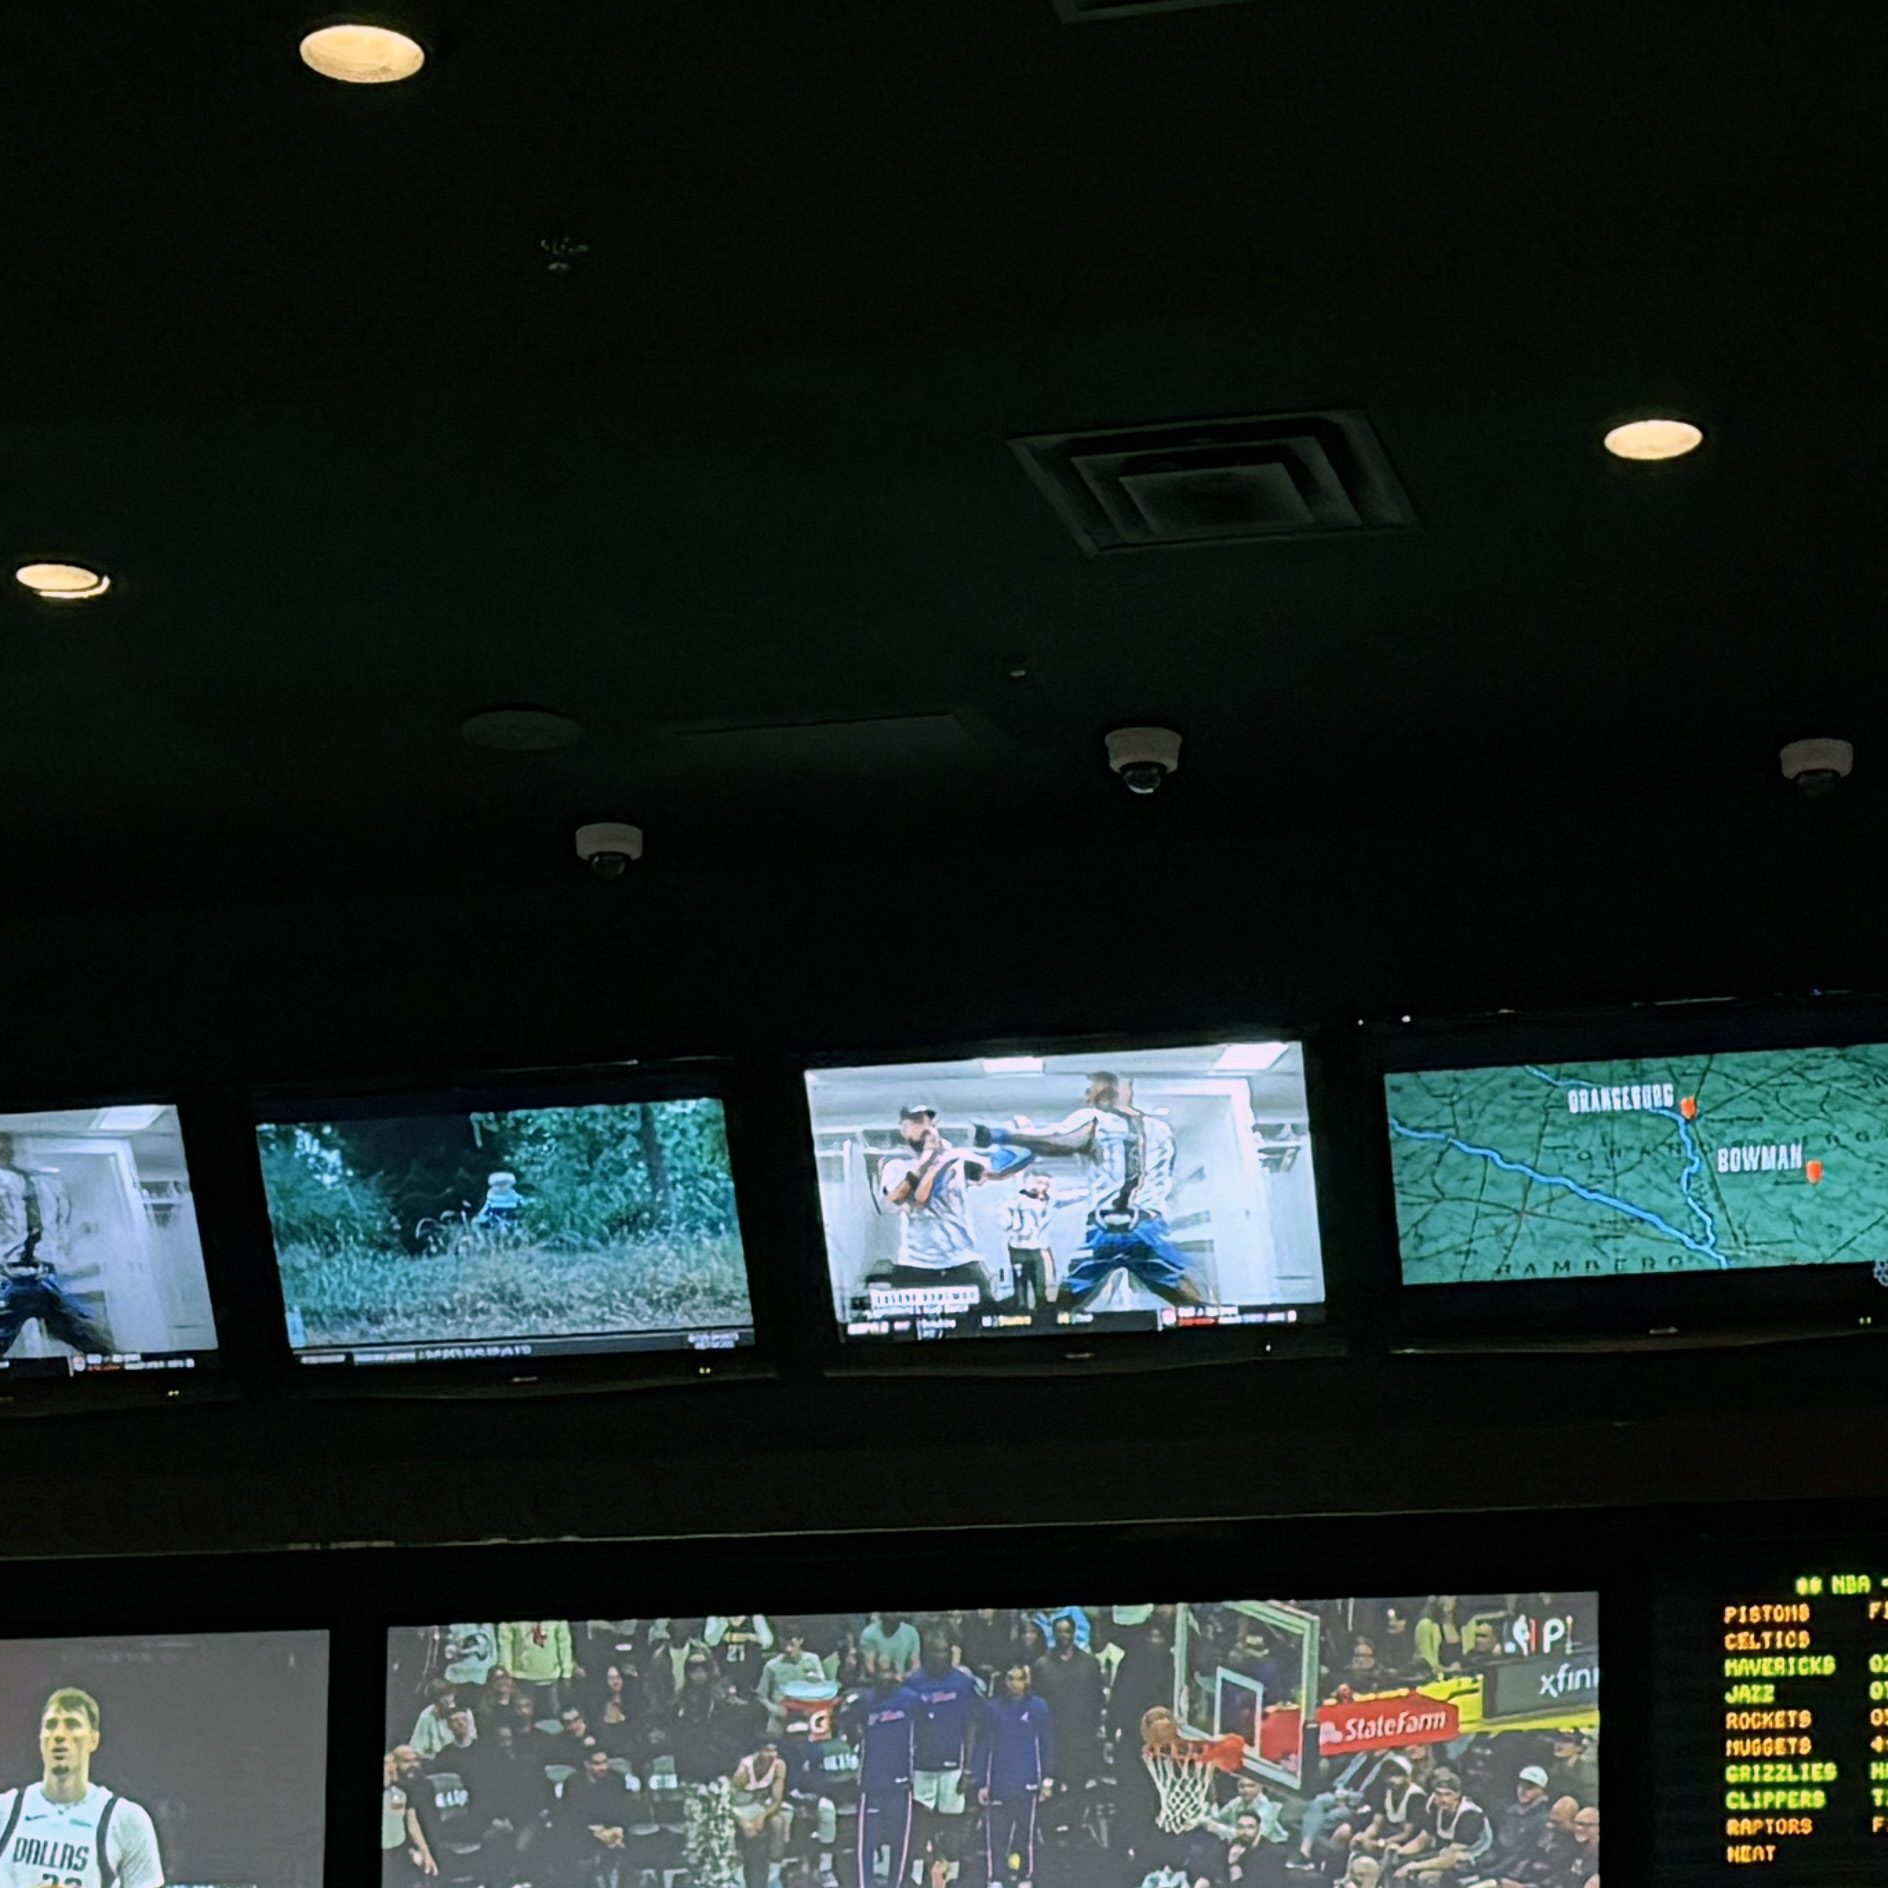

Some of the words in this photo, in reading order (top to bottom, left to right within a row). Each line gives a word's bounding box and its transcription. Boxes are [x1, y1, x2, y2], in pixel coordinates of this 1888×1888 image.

[1568, 1084, 1674, 1114] ORANGEBURG
[1718, 1143, 1802, 1174] BOWMAN
[1831, 1575, 1871, 1594] NBA
[1724, 1603, 1810, 1624] PISTONS
[1725, 1630, 1810, 1650] CELTICS
[1725, 1655, 1836, 1677] MAVERICKS
[1725, 1684, 1775, 1704] JAZZ
[1345, 1710, 1446, 1742] StateFarm
[1726, 1710, 1812, 1730] ROCKETS
[1726, 1736, 1812, 1756] NUGGETS
[1725, 1762, 1837, 1784] GRIZZLIES
[1726, 1789, 1826, 1810] CLIPPERS
[1726, 1818, 1812, 1836] RAPTORS
[13, 1837, 89, 1871] DALLAS
[1727, 1845, 1776, 1863] HEAT
